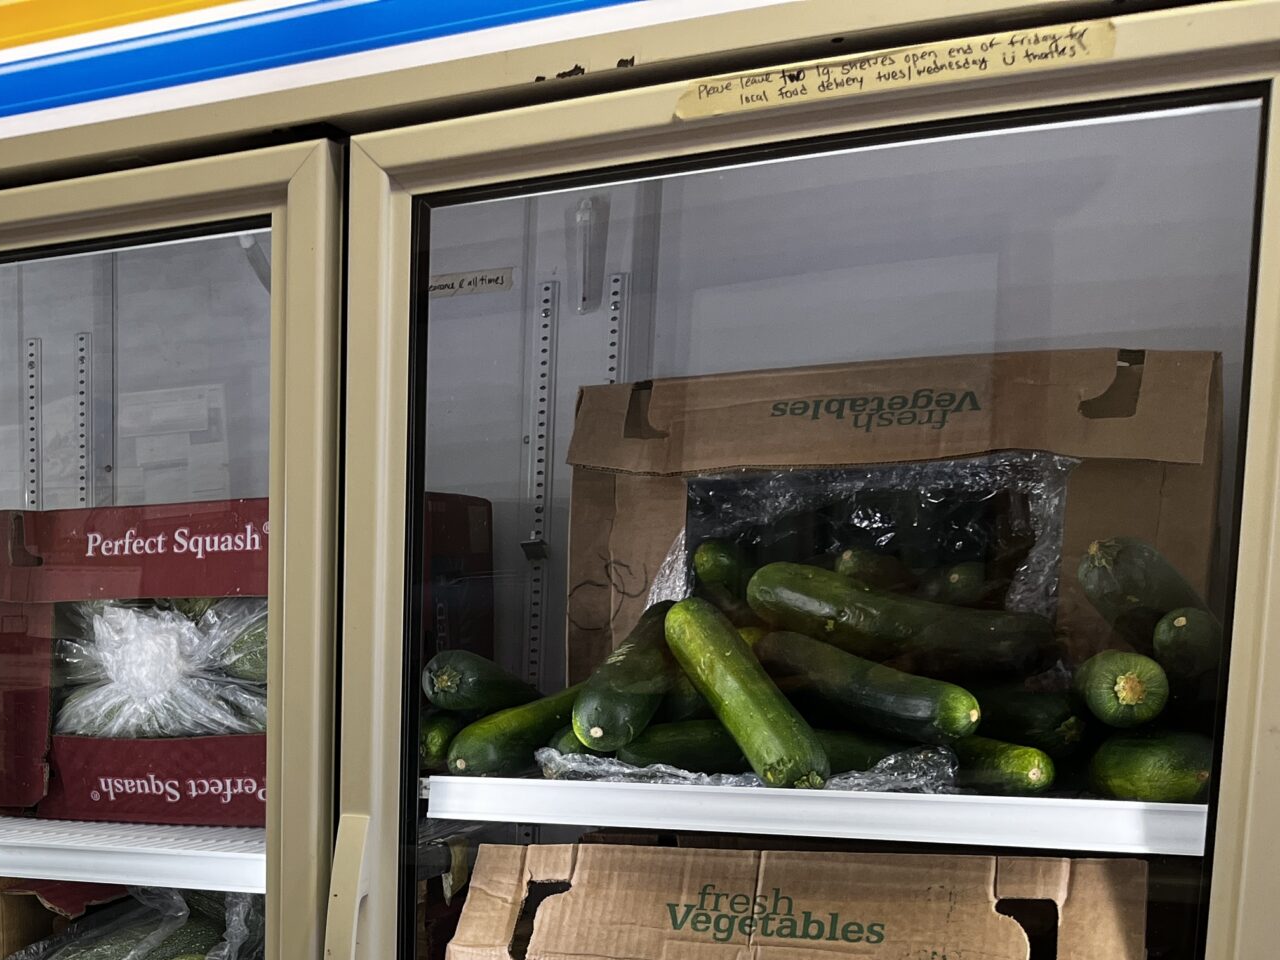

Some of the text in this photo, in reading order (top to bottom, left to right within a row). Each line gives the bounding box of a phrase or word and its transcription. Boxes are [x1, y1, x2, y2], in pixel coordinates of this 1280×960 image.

[697, 81, 732, 100] Please
[740, 73, 773, 90] leave
[780, 67, 806, 85] two
[841, 54, 896, 75] shelves
[904, 49, 938, 67] open
[948, 44, 973, 59] end
[980, 37, 1001, 52] of
[1007, 31, 1064, 48] friday
[740, 90, 769, 105] local
[778, 86, 808, 100] food
[770, 388, 982, 420] Vegetables
[852, 408, 951, 433] fresh
[85, 528, 166, 558] Perfect
[695, 883, 796, 917] fresh
[666, 902, 886, 944] Vegetables
